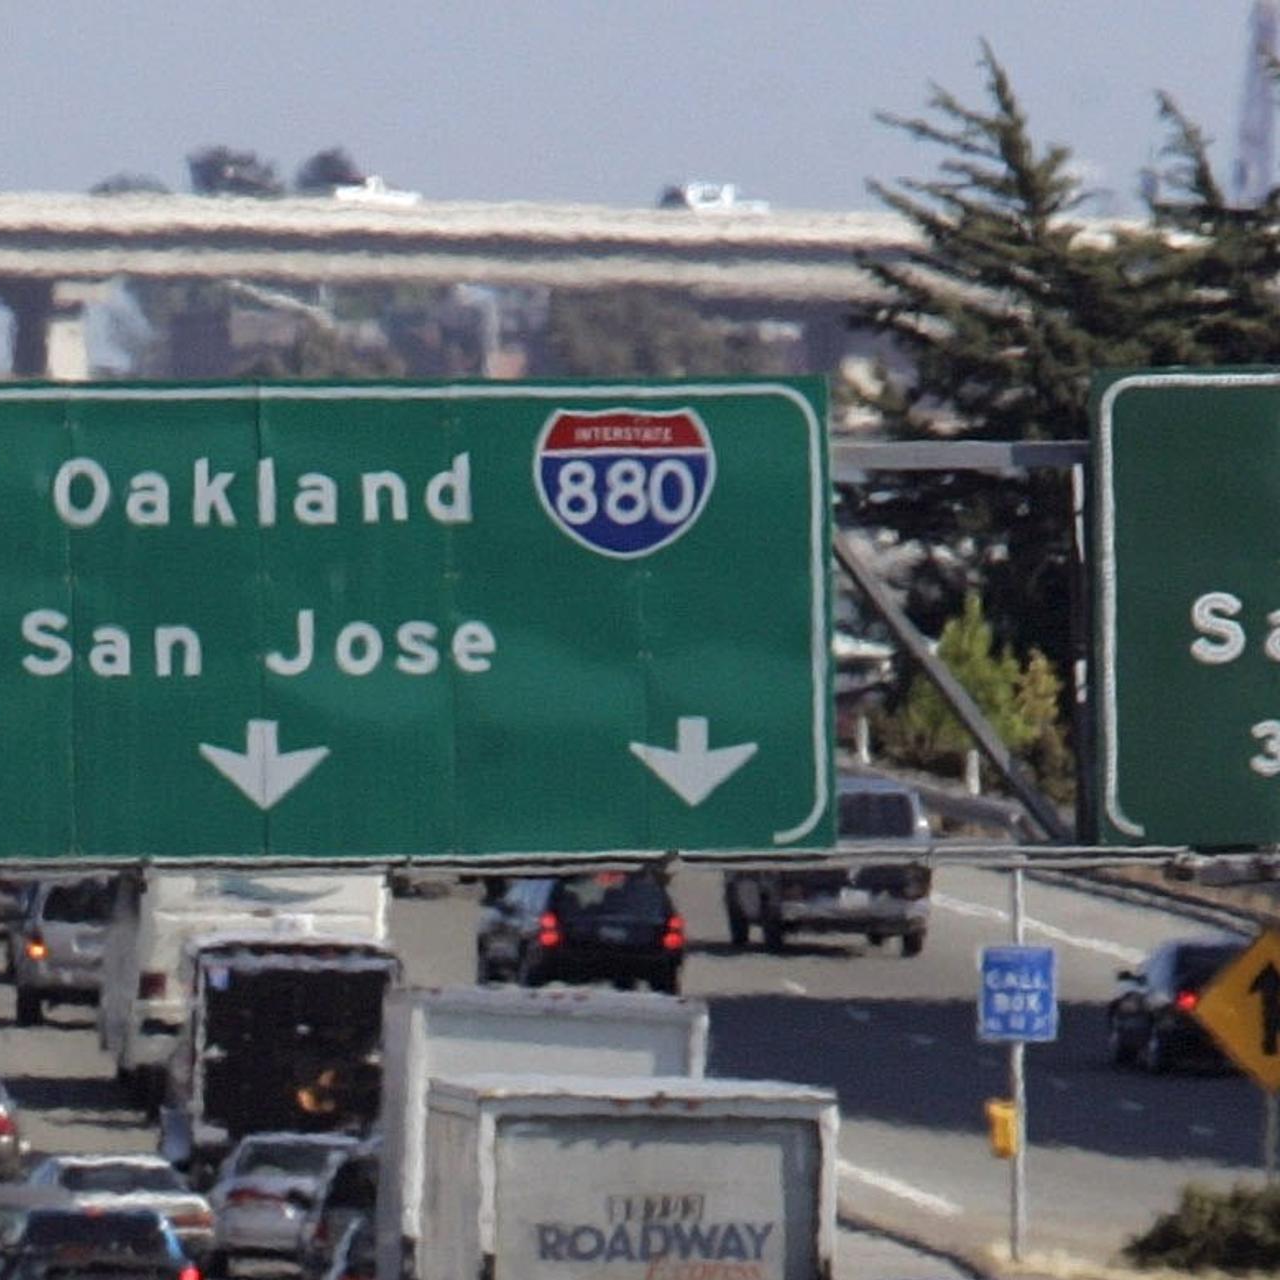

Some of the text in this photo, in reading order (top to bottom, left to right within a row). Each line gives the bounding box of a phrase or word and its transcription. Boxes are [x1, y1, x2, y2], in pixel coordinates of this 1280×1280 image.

[575, 427, 676, 444] INTERSTATE
[54, 453, 470, 525] Oakland
[557, 461, 696, 525] 880
[22, 609, 495, 676] San Jose
[985, 969, 1049, 989] CALL
[537, 1222, 774, 1263] ROADWAY
